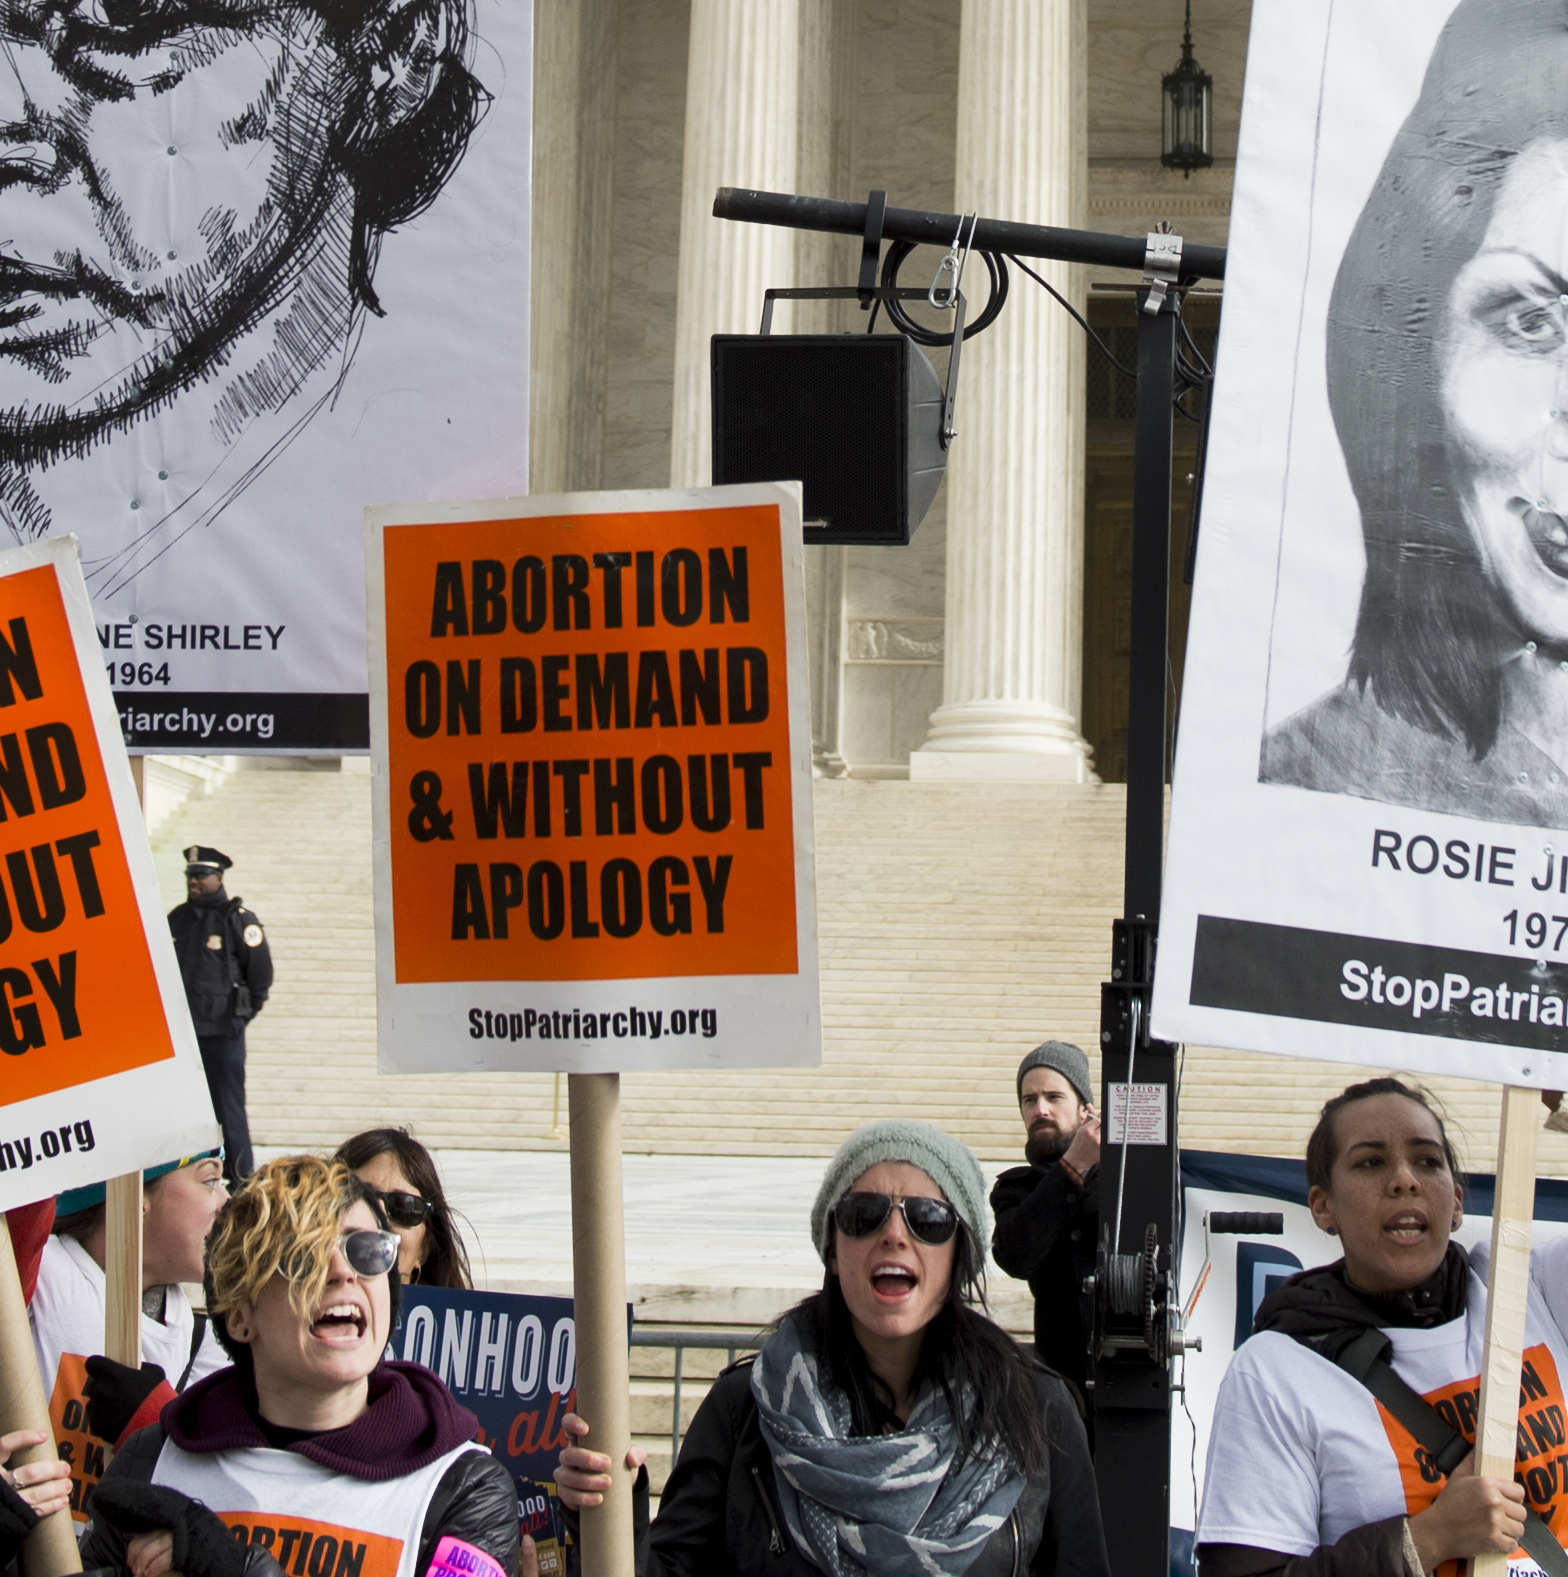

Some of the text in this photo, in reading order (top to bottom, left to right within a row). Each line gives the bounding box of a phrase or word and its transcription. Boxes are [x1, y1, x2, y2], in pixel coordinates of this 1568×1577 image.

[430, 545, 751, 638] ABORTION
[144, 624, 286, 650] SHIRLEY
[106, 662, 171, 686] 1964
[403, 646, 771, 739] ON DEMAND
[407, 751, 773, 844] & WITHOUT
[1371, 828, 1517, 887] ROSIE
[450, 855, 735, 941] APOLOGY
[468, 1006, 719, 1043] StopPatriarchy.org
